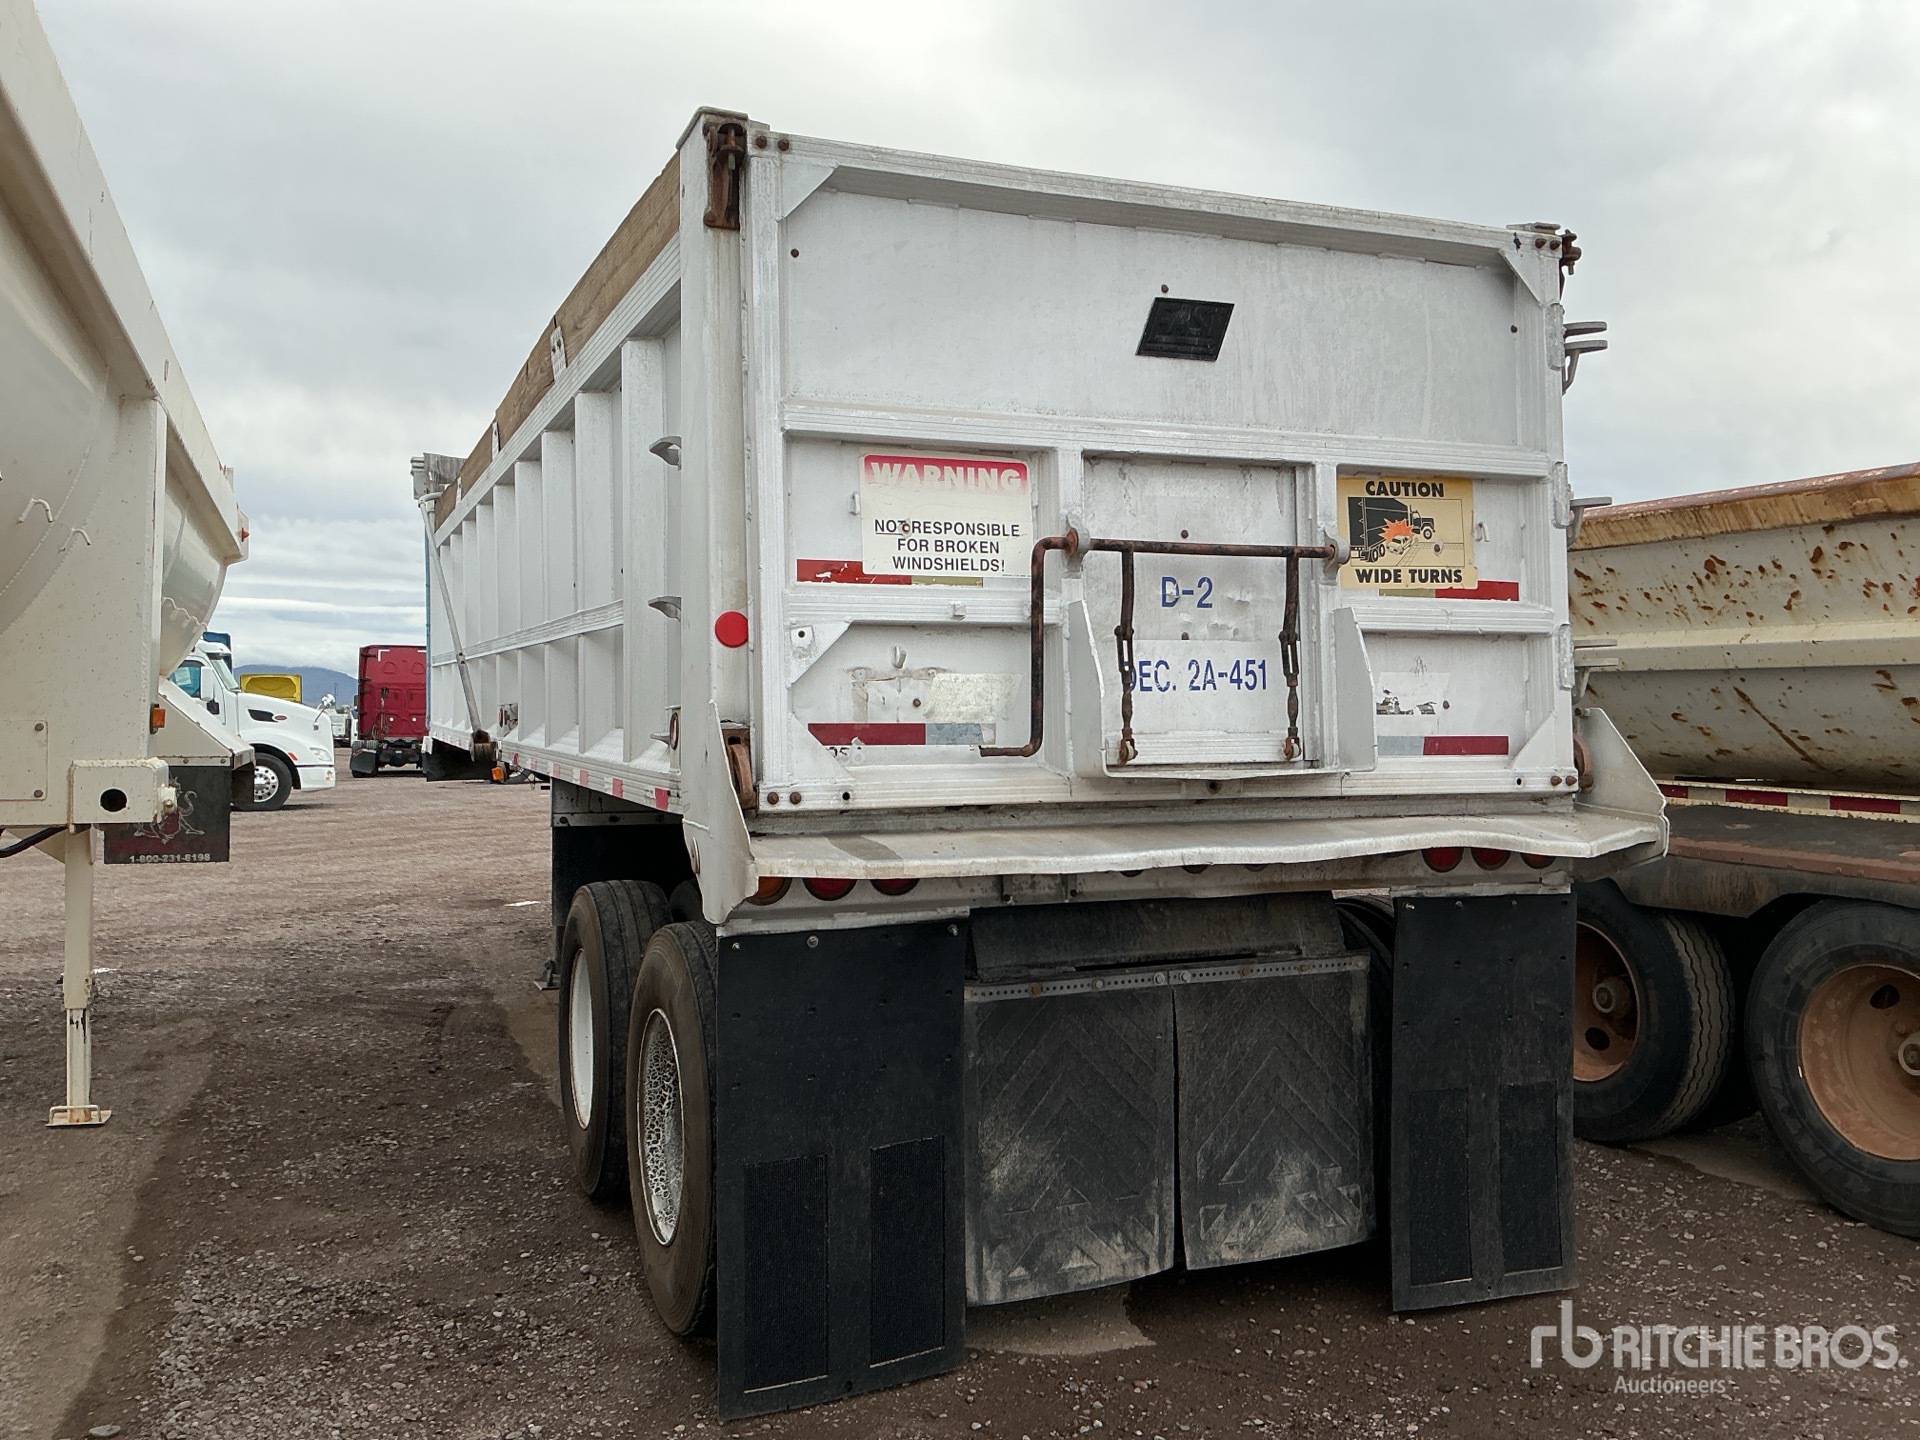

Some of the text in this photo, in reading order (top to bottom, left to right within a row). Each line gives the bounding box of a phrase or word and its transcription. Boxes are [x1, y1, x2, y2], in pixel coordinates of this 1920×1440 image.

[870, 462, 1022, 492] WARNING
[1365, 480, 1444, 498] CAUTION
[911, 520, 1020, 537] RESPONSIBLE
[897, 537, 1000, 554] FOR BROKEN
[892, 556, 1006, 572] WINDSHIELDS!
[1355, 568, 1463, 584] WIDE TURNS
[1161, 576, 1213, 608] D-2
[1187, 659, 1267, 692] 2A-451
